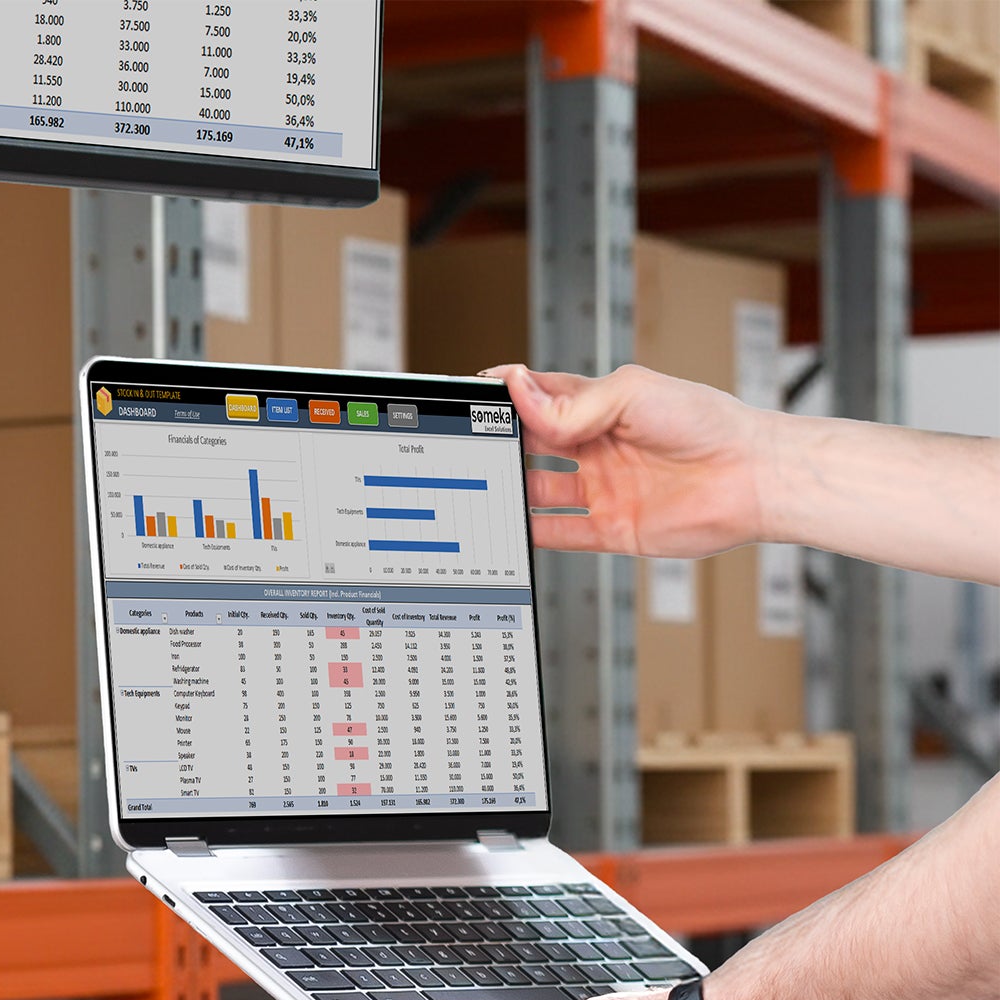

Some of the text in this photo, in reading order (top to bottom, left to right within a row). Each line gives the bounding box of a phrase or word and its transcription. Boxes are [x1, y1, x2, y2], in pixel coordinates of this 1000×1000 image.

[124, 0, 148, 11] 3.750
[206, 5, 231, 16] 1.250
[36, 14, 64, 26] 18.000
[288, 10, 317, 22] 33,3%
[120, 20, 150, 32] 37.500
[206, 26, 230, 37] 7.500
[38, 34, 61, 46] 1.800
[288, 31, 316, 44] 20,0%
[120, 40, 149, 52] 33.000
[202, 46, 232, 58] 11.000
[34, 54, 63, 66] 28.420
[288, 52, 316, 64] 33,3%
[119, 60, 148, 72] 36.000
[204, 67, 229, 78] 7.000
[34, 74, 62, 86] 11.550
[287, 73, 315, 86] 19,4%
[118, 81, 148, 93] 30.000
[200, 88, 231, 99] 15.000
[33, 94, 62, 106] 11.200
[286, 94, 314, 106] 50,0%
[116, 101, 150, 114] 110.000
[199, 108, 230, 120] 40.000
[30, 116, 64, 128] 165.982
[286, 115, 314, 127] 36,4%
[115, 122, 150, 135] 372.300
[197, 130, 232, 142] 175.169
[284, 137, 314, 150] 47,1%
[118, 389, 180, 400] STOCK IN & OUT TEMPLATE
[119, 407, 156, 417] DASHBOARD
[314, 408, 335, 416] RECEIVED
[472, 408, 511, 424] someka
[168, 434, 227, 447] Financials of Categories
[398, 444, 424, 453] Total Profit
[129, 609, 152, 618] Categories
[366, 619, 384, 627] Quantity
[140, 628, 160, 636] appliance
[135, 690, 160, 698] Equipments
[174, 690, 215, 698] Computer Keyboard
